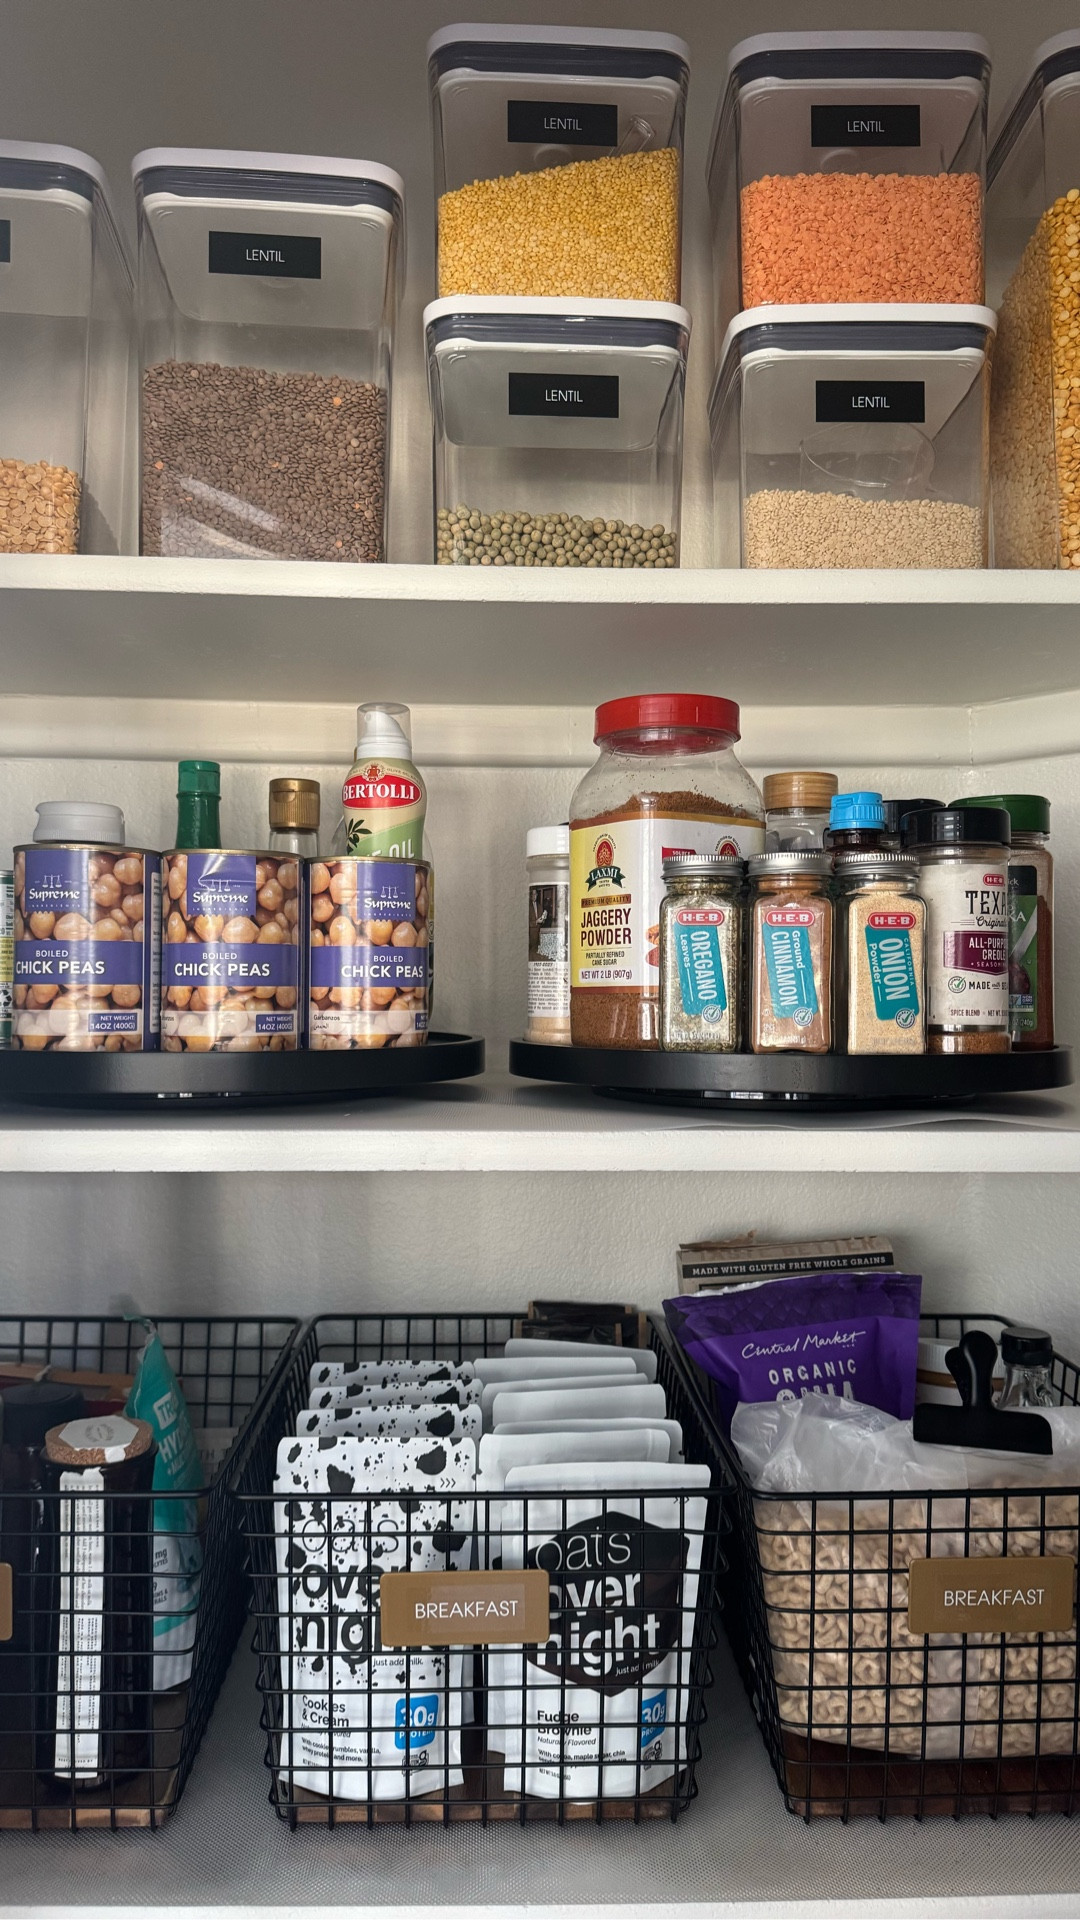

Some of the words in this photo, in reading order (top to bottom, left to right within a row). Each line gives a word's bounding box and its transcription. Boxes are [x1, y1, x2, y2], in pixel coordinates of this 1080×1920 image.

[543, 117, 583, 132] LENTIL
[847, 119, 886, 134] LENTIL
[245, 248, 285, 264] LENTIL
[544, 388, 584, 404] LENTIL
[851, 395, 891, 410] LENTIL
[343, 783, 415, 800] BERTOLLI
[590, 867, 618, 881] LAXMI
[29, 888, 80, 902] Supreme
[192, 891, 248, 905] Supreme
[364, 898, 411, 911] Supreme
[581, 908, 632, 929] JAGGERY
[581, 928, 632, 947] POWDER
[35, 950, 69, 958] BOILED
[202, 952, 237, 960] BOILED
[680, 934, 691, 968] Leaves
[792, 930, 805, 969] Ground
[373, 955, 404, 963] BOILED
[690, 930, 718, 1001] OREGANO
[868, 943, 882, 985] Powder
[903, 937, 915, 986] CALIFORNIA
[16, 961, 53, 975] CHICK
[58, 961, 105, 975] PEAS
[174, 963, 221, 977] CHICK
[227, 963, 270, 977] PEAS
[341, 965, 390, 978] CHICK
[395, 965, 423, 978] PEAS
[591, 970, 599, 979] WT
[604, 970, 612, 979] LB
[612, 969, 632, 980] (907g)
[771, 931, 799, 1006] CINNAMON
[878, 937, 911, 1001] ONION
[969, 981, 991, 990] MADE
[692, 1266, 719, 1276] MADE
[721, 1265, 746, 1274] WITH
[748, 1263, 786, 1273] GLUTEN
[789, 1261, 812, 1270] FREE
[814, 1259, 848, 1268] WHOLE
[850, 1256, 887, 1266] GRAINS
[741, 1338, 800, 1359] Central
[802, 1331, 866, 1351] Market
[768, 1359, 857, 1385] ORGANIC
[302, 1510, 399, 1552] oats
[536, 1526, 631, 1571] oats
[301, 1564, 409, 1599] ove
[944, 1589, 1045, 1607] BREAKFAST
[415, 1601, 519, 1620] BREAKFAST
[537, 1613, 660, 1677] night
[373, 1658, 388, 1668] just
[389, 1658, 405, 1666] add
[615, 1665, 630, 1677] just
[630, 1663, 645, 1673] ad
[302, 1694, 346, 1713] Cookes
[302, 1708, 308, 1721] &
[310, 1711, 350, 1727] Cream
[400, 1705, 435, 1728] 30g
[537, 1709, 579, 1725] Fudge
[642, 1702, 666, 1724] 30g
[537, 1736, 566, 1746] Naturay
[567, 1738, 597, 1747] Flavored
[314, 1750, 330, 1758] protei
[331, 1746, 358, 1754] rumbles,
[538, 1748, 552, 1758] With
[552, 1753, 573, 1761] cooa,
[573, 1753, 594, 1761] maple
